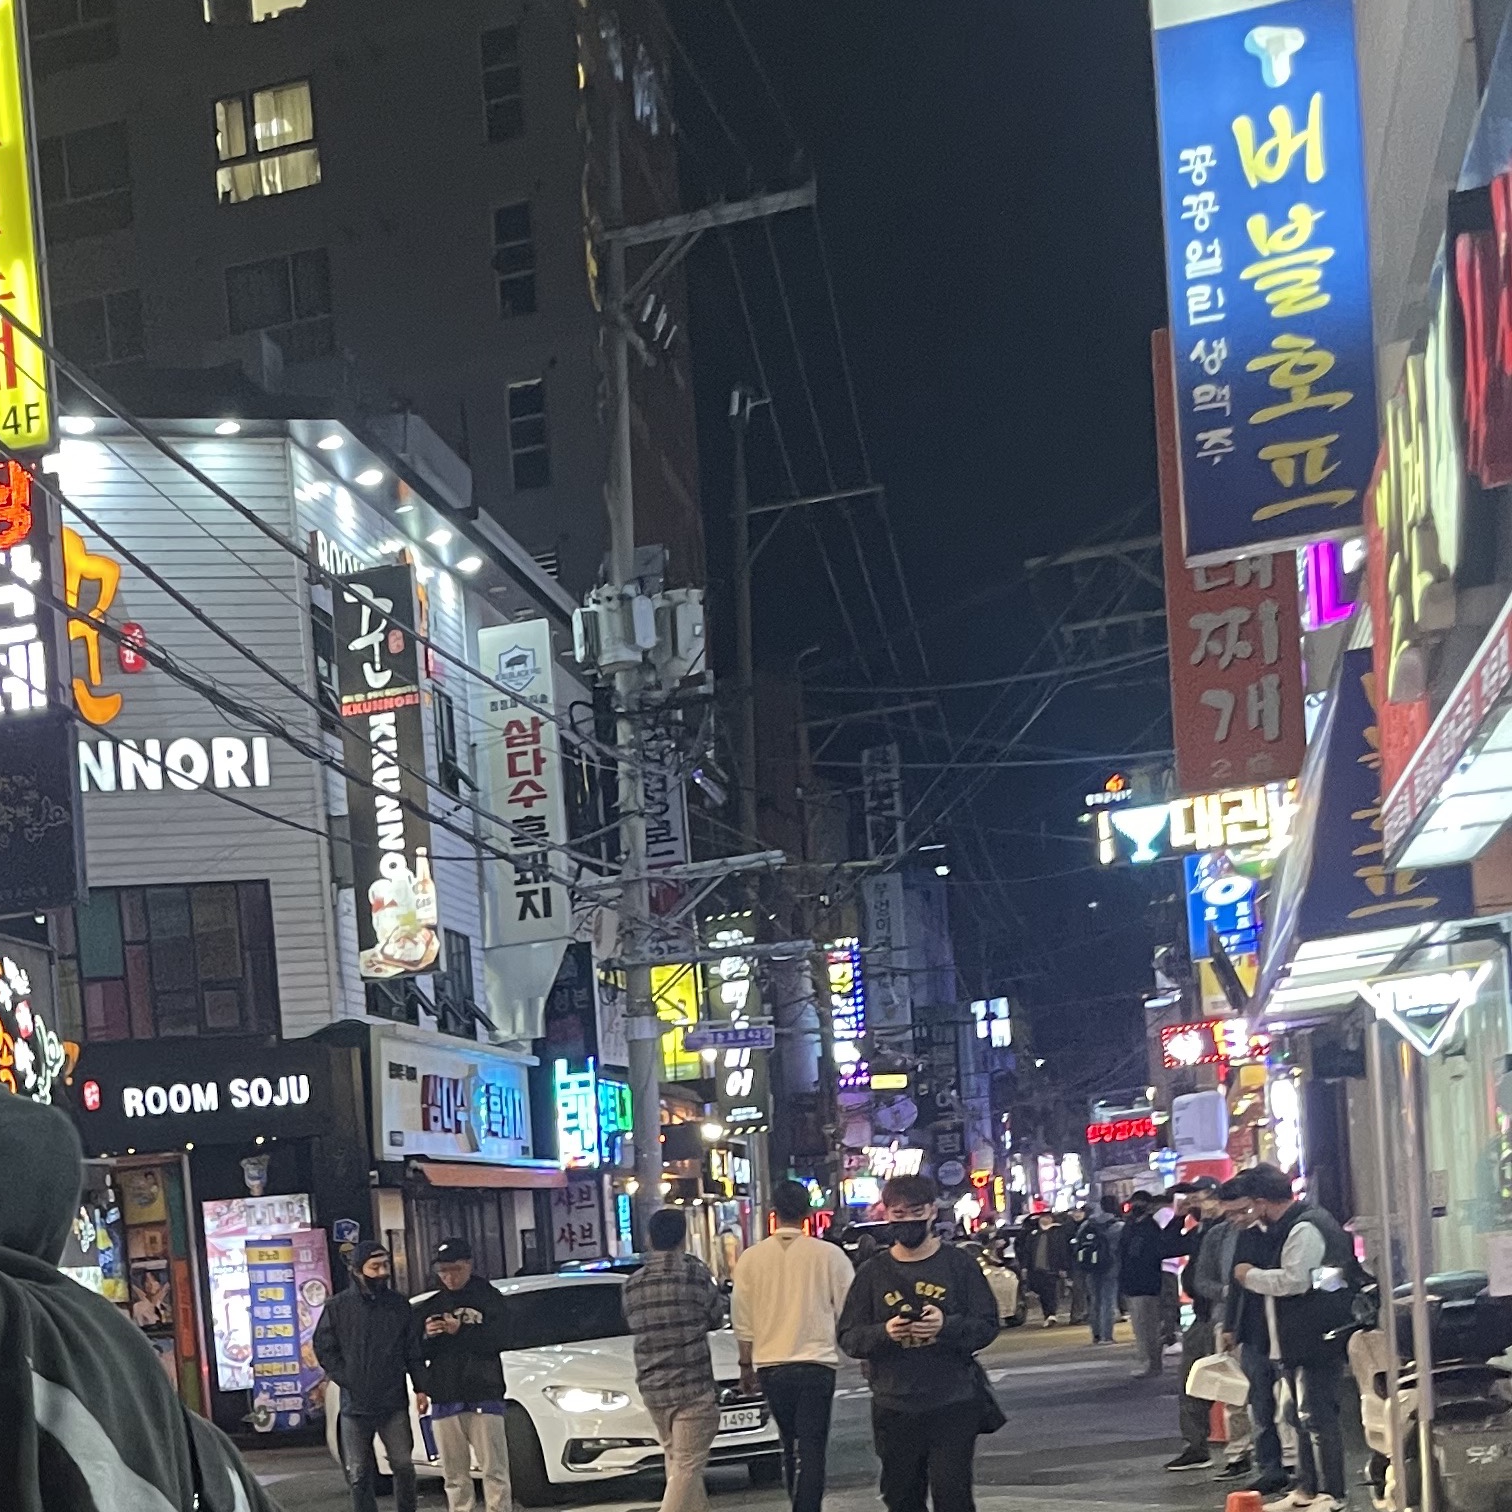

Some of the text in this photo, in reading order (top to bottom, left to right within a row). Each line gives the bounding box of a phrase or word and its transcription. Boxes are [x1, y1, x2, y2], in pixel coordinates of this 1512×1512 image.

[503, 716, 548, 808] 삼다수
[123, 1081, 219, 1118] ROOM
[229, 1074, 311, 1108] SOJU
[722, 1411, 754, 1428] 1499
